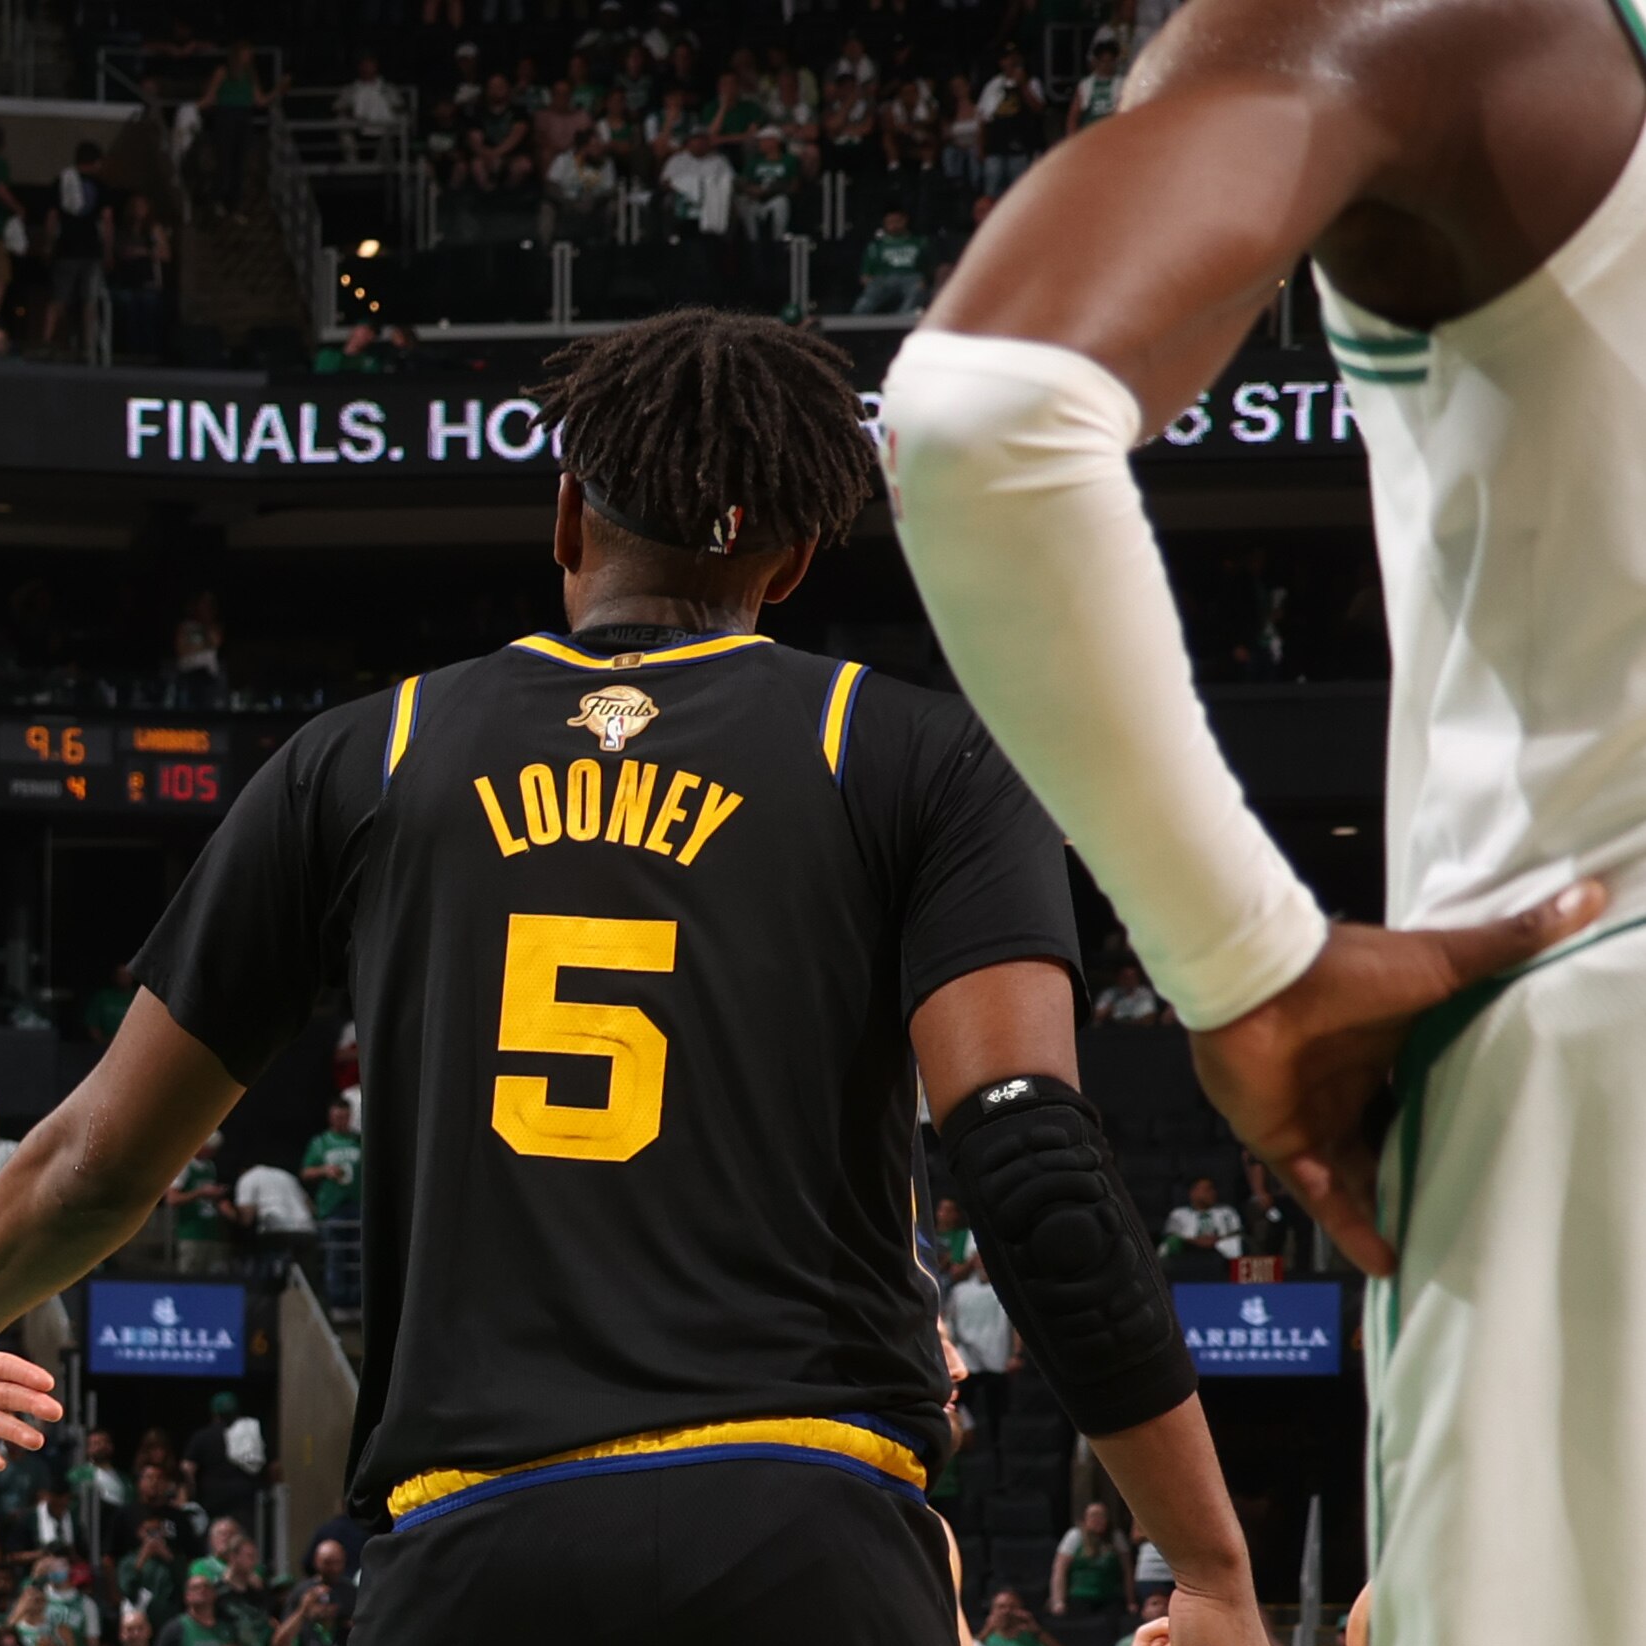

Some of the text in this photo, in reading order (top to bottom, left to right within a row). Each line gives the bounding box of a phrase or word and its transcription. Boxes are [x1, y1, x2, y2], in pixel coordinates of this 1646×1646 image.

[126, 397, 405, 464] FINALS.
[568, 694, 654, 726] Finals
[25, 725, 86, 765] 9.6
[67, 775, 86, 800] 4
[160, 764, 218, 802] 105
[474, 758, 744, 867] LOONEY
[491, 912, 678, 1162] 5
[1184, 1327, 1329, 1348] ARBELLA
